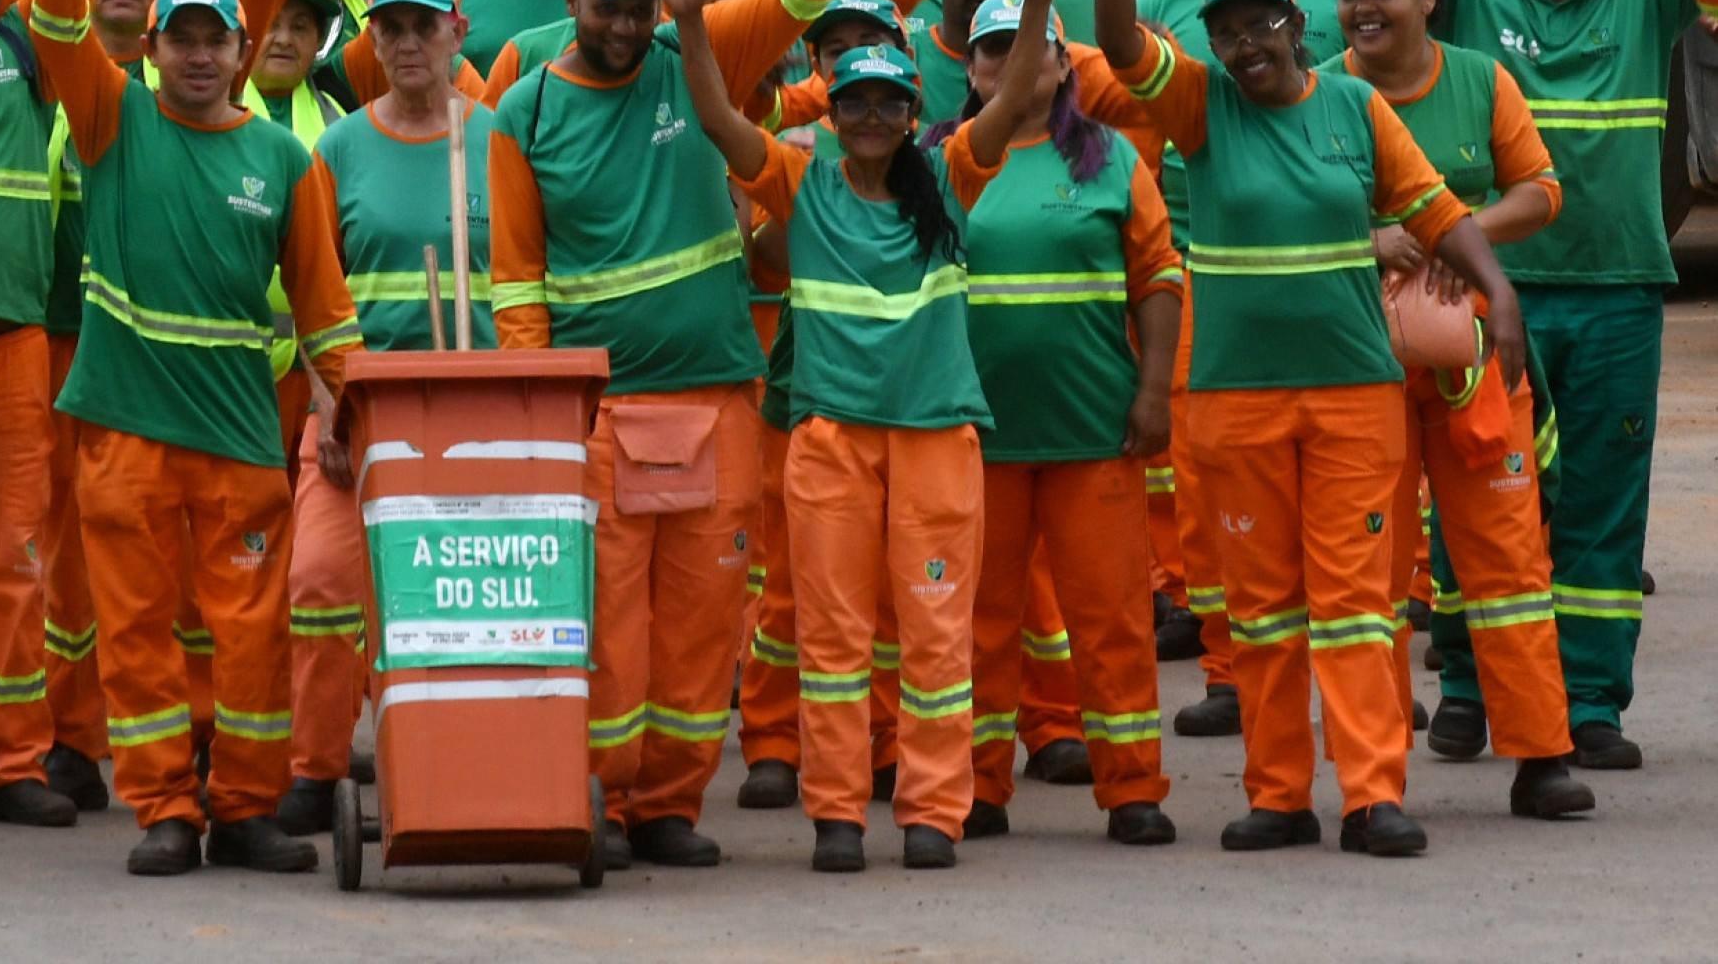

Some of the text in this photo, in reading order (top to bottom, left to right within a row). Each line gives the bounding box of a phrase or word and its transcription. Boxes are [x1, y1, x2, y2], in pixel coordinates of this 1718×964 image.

[413, 534, 559, 572] A SERVIÇO
[435, 577, 539, 609] DO SLU.
